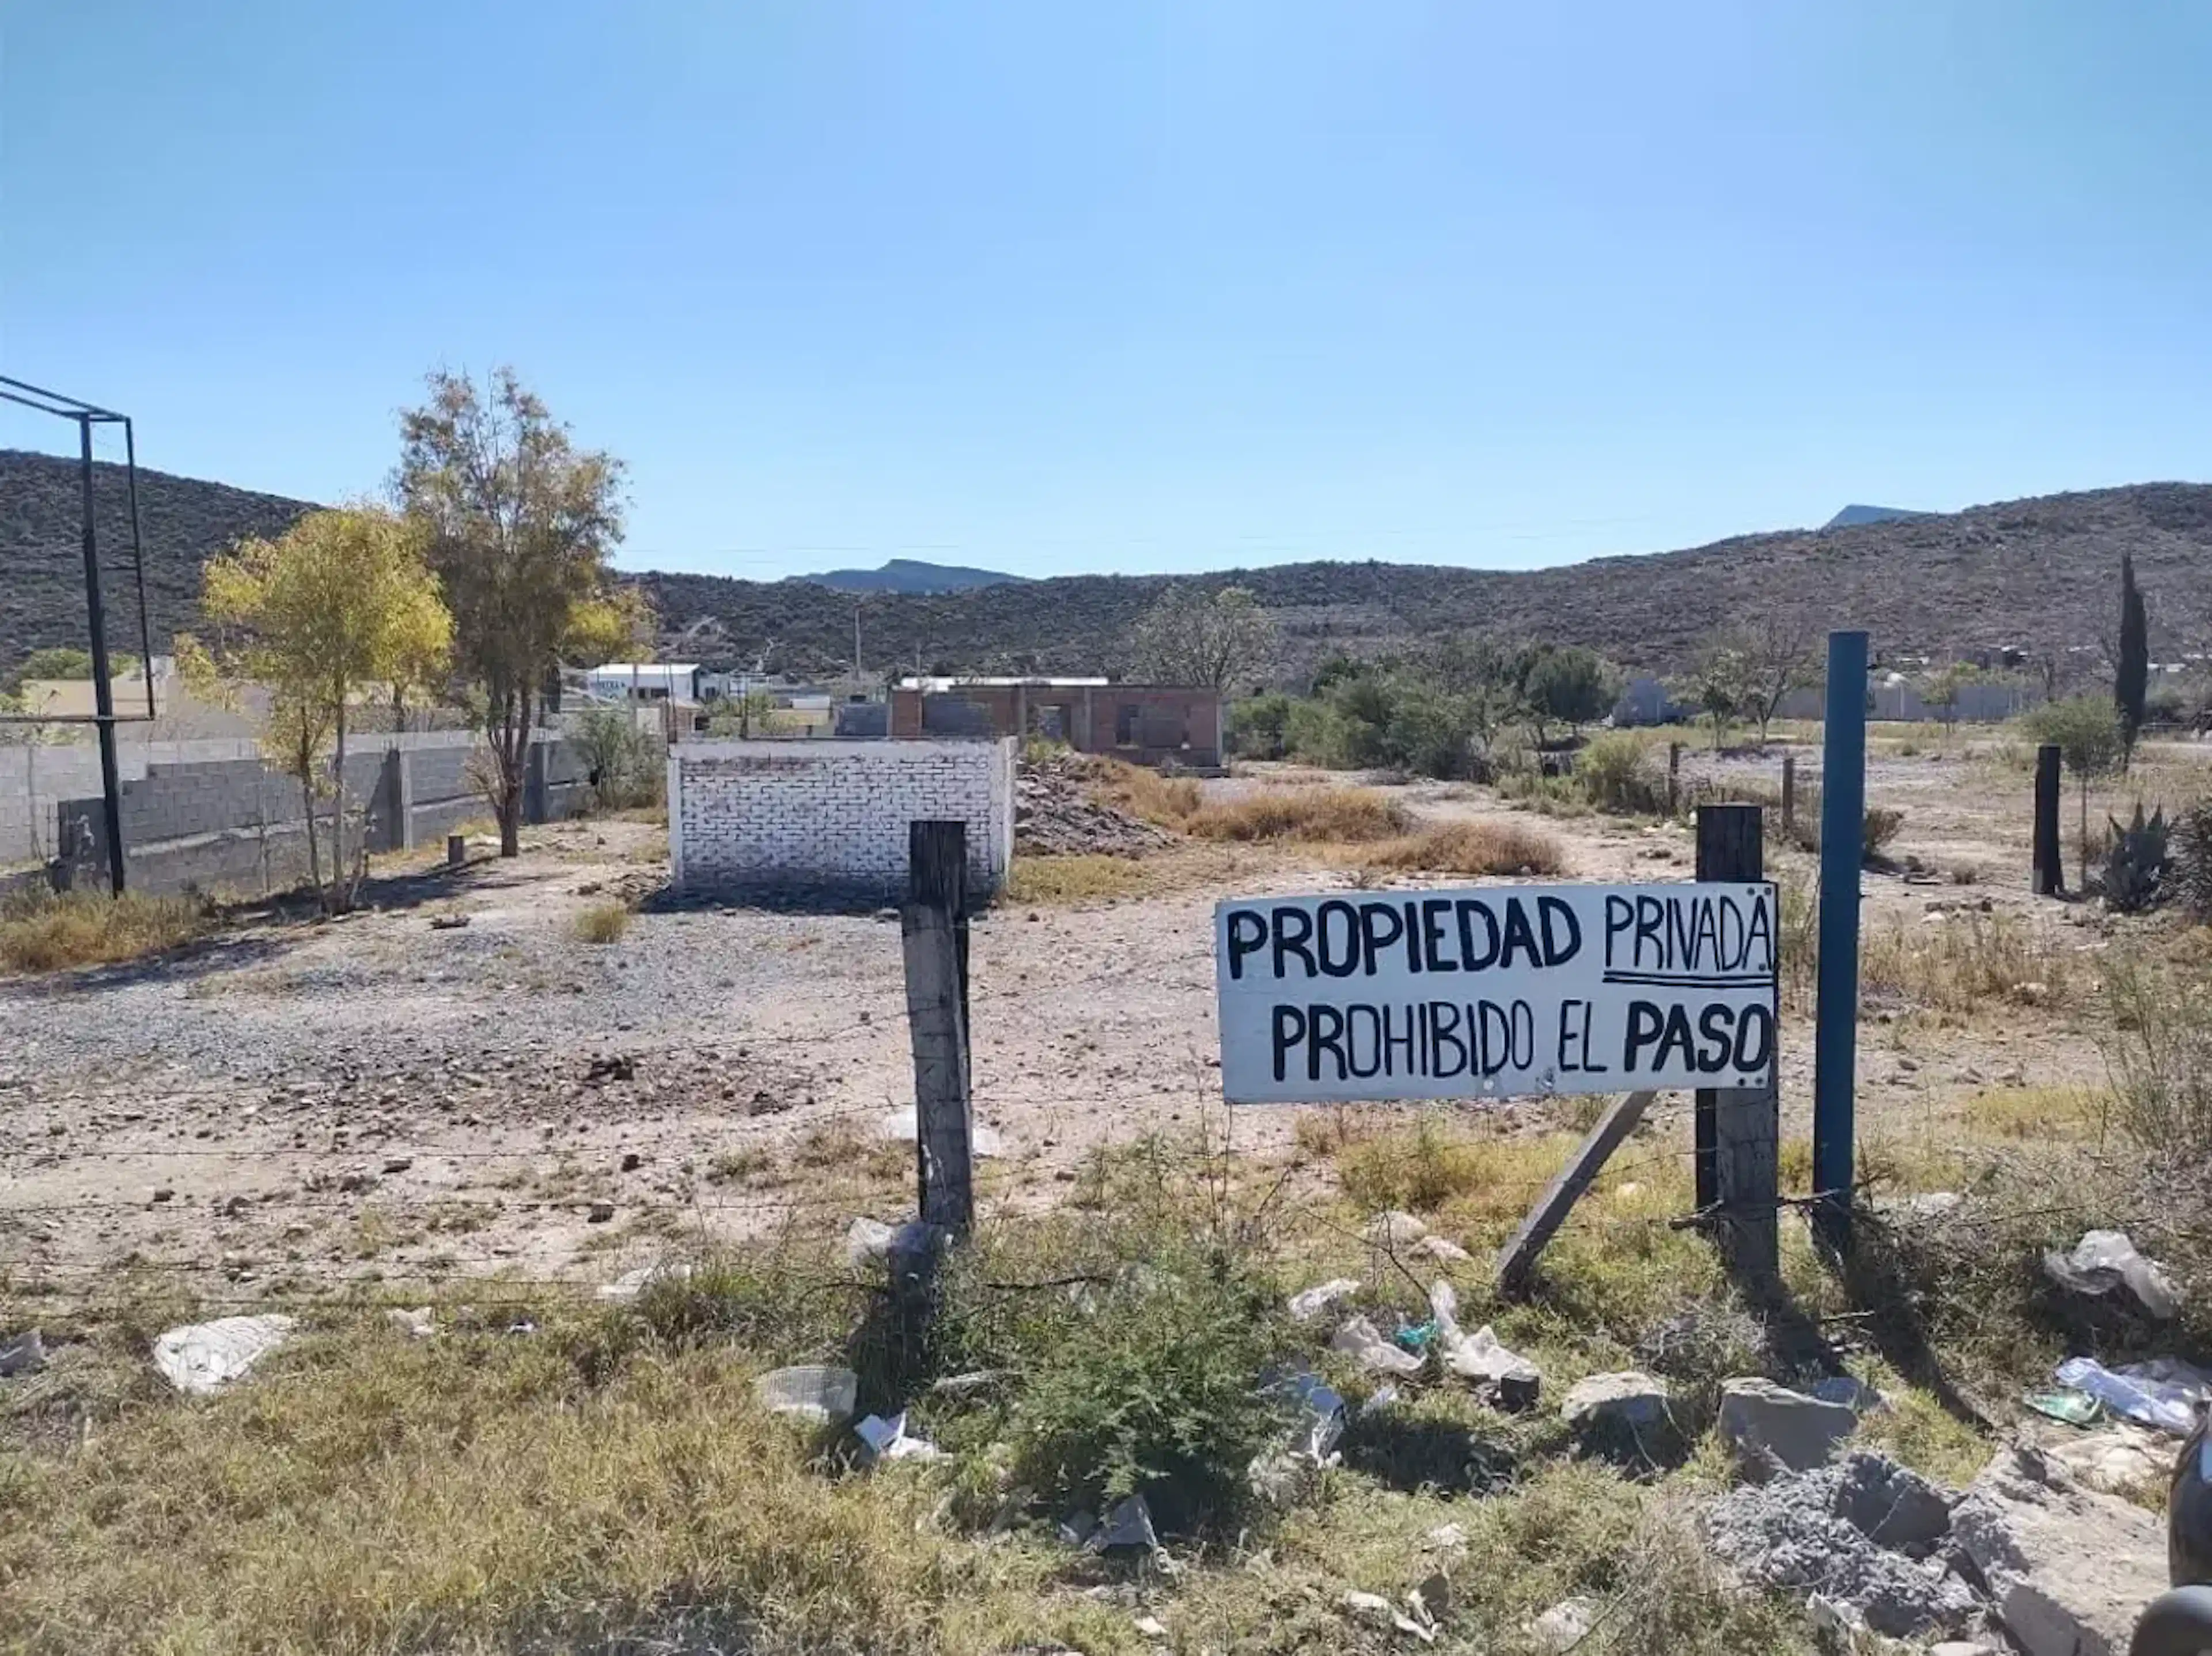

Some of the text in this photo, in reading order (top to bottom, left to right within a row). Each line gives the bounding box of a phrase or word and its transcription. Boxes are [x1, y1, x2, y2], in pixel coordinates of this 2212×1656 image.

[1227, 895, 1773, 980] PROPIEDAD PRIVADA
[1273, 999, 1772, 1081] PROHIBIDO EL PASO
